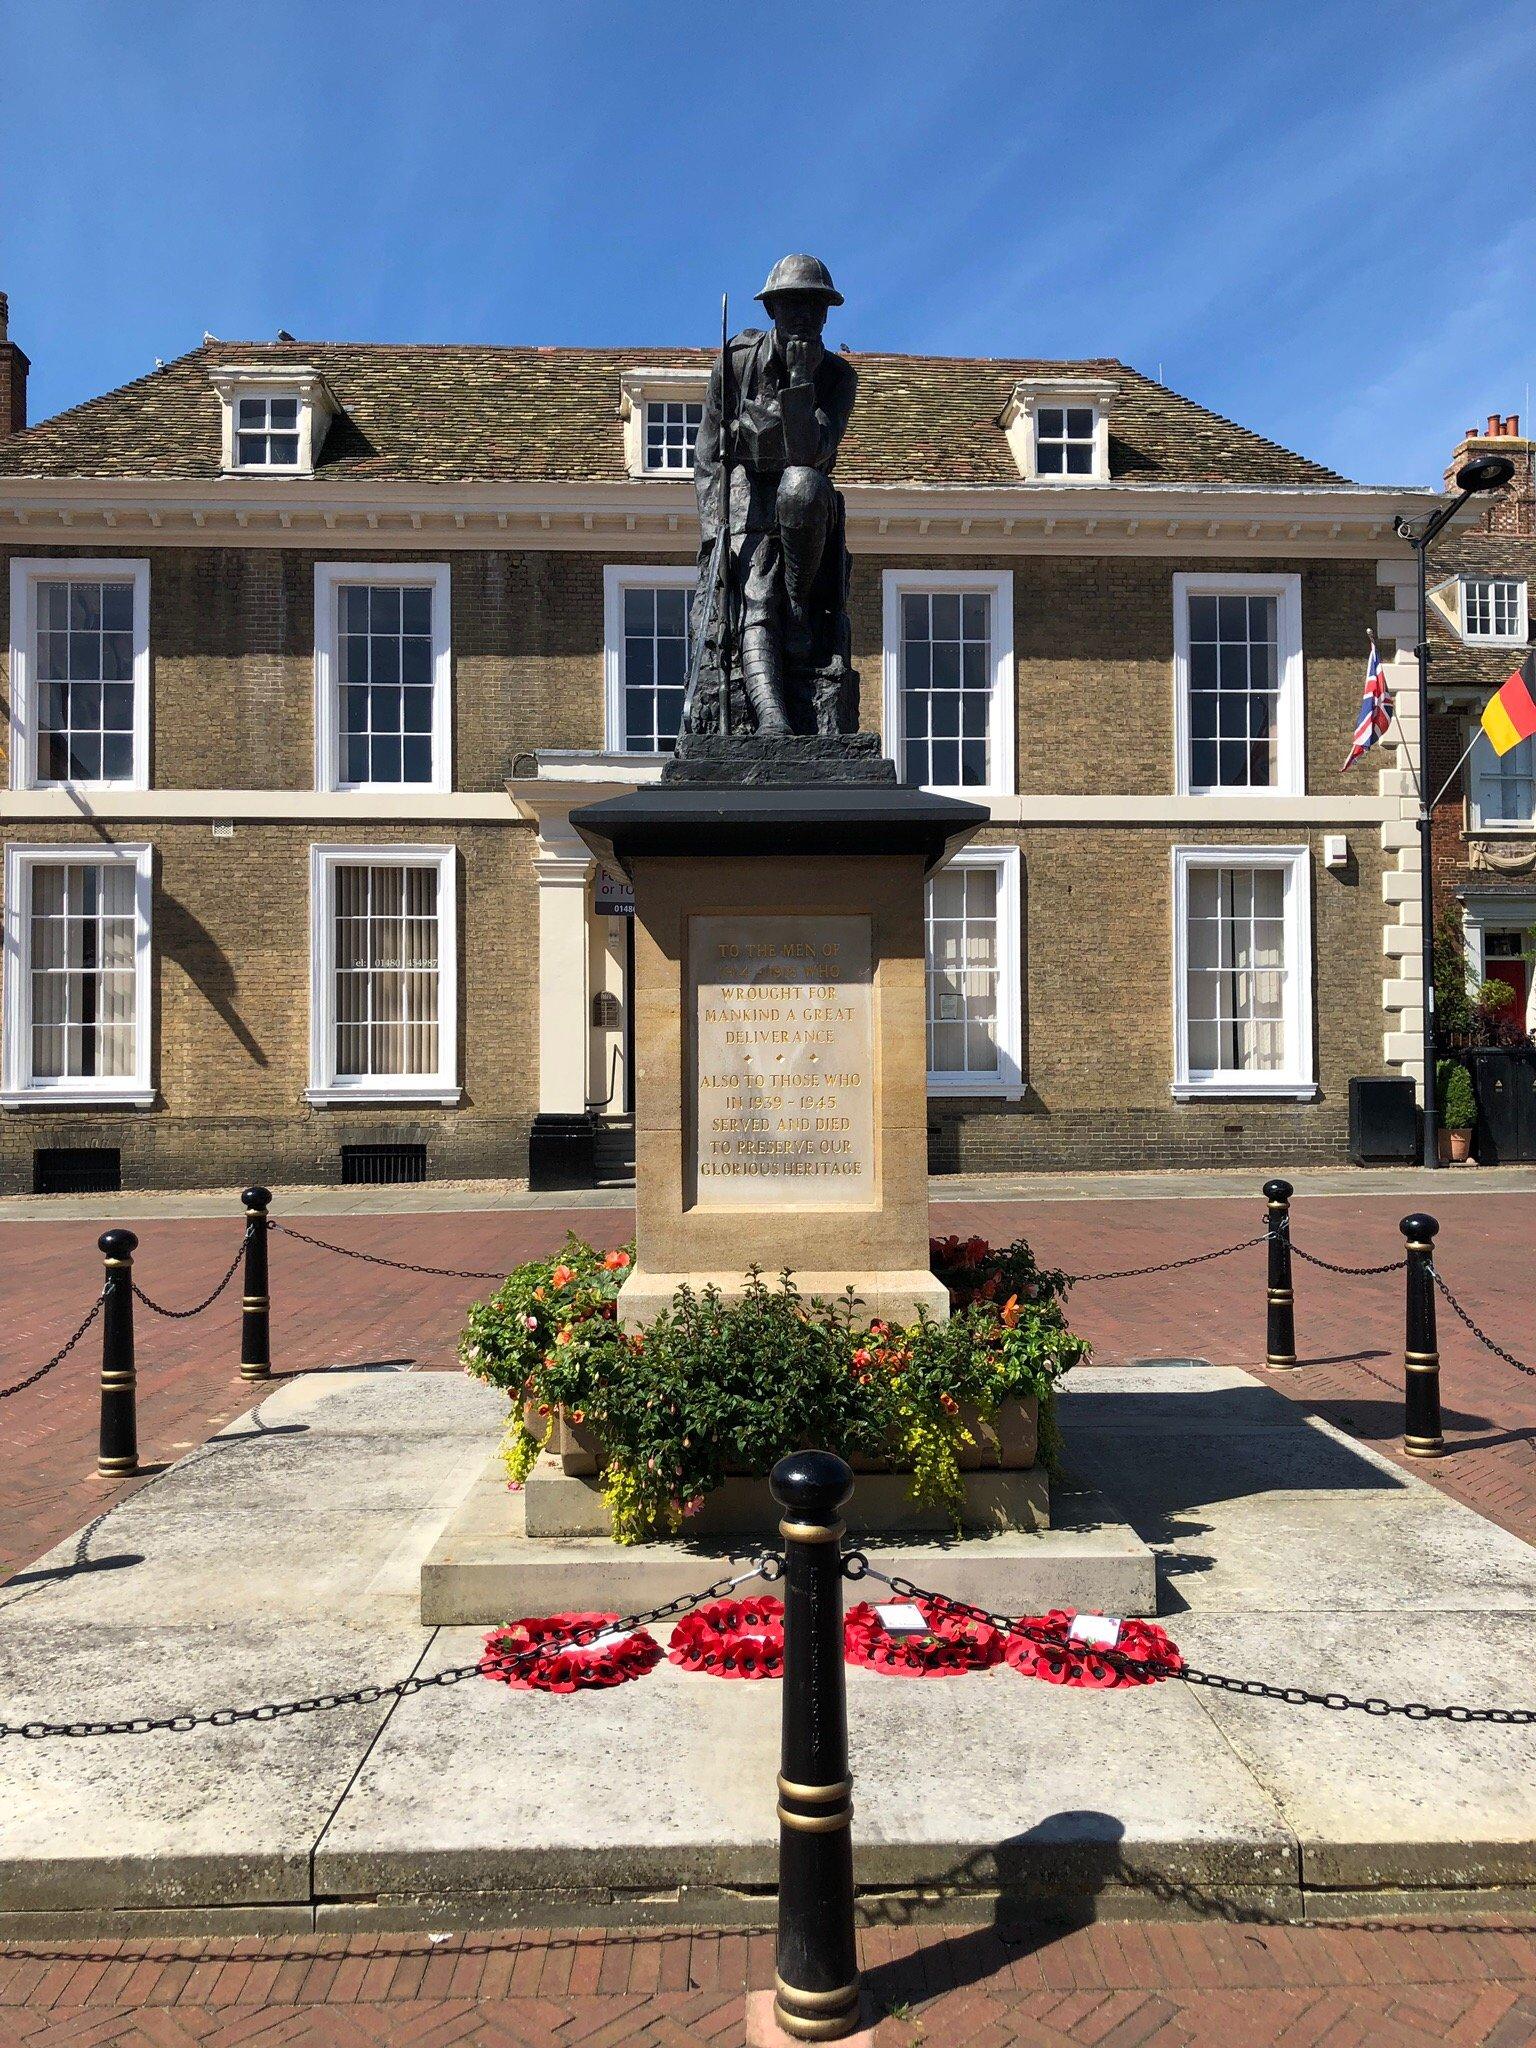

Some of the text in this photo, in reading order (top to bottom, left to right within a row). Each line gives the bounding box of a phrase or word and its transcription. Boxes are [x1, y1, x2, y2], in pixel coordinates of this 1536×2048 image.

[602, 886, 614, 894] or
[718, 944, 840, 957] TO THE MEN OF
[375, 959, 400, 967] 01480
[804, 965, 840, 978] WHO
[721, 987, 837, 1000] WROUGHT FOR
[705, 1008, 855, 1022] MANKIND A GREAT
[726, 1030, 834, 1044] DELIVERANCE
[700, 1074, 861, 1088] ALSO TO THOSE WHO
[726, 1097, 743, 1109] IN
[749, 1097, 782, 1110] 1939
[800, 1096, 836, 1109] 1945
[712, 1118, 850, 1132] SERVED AND DIED
[709, 1140, 853, 1155] TO PRESERVE OUR
[701, 1162, 862, 1176] GLORIOUS HERITAGE
